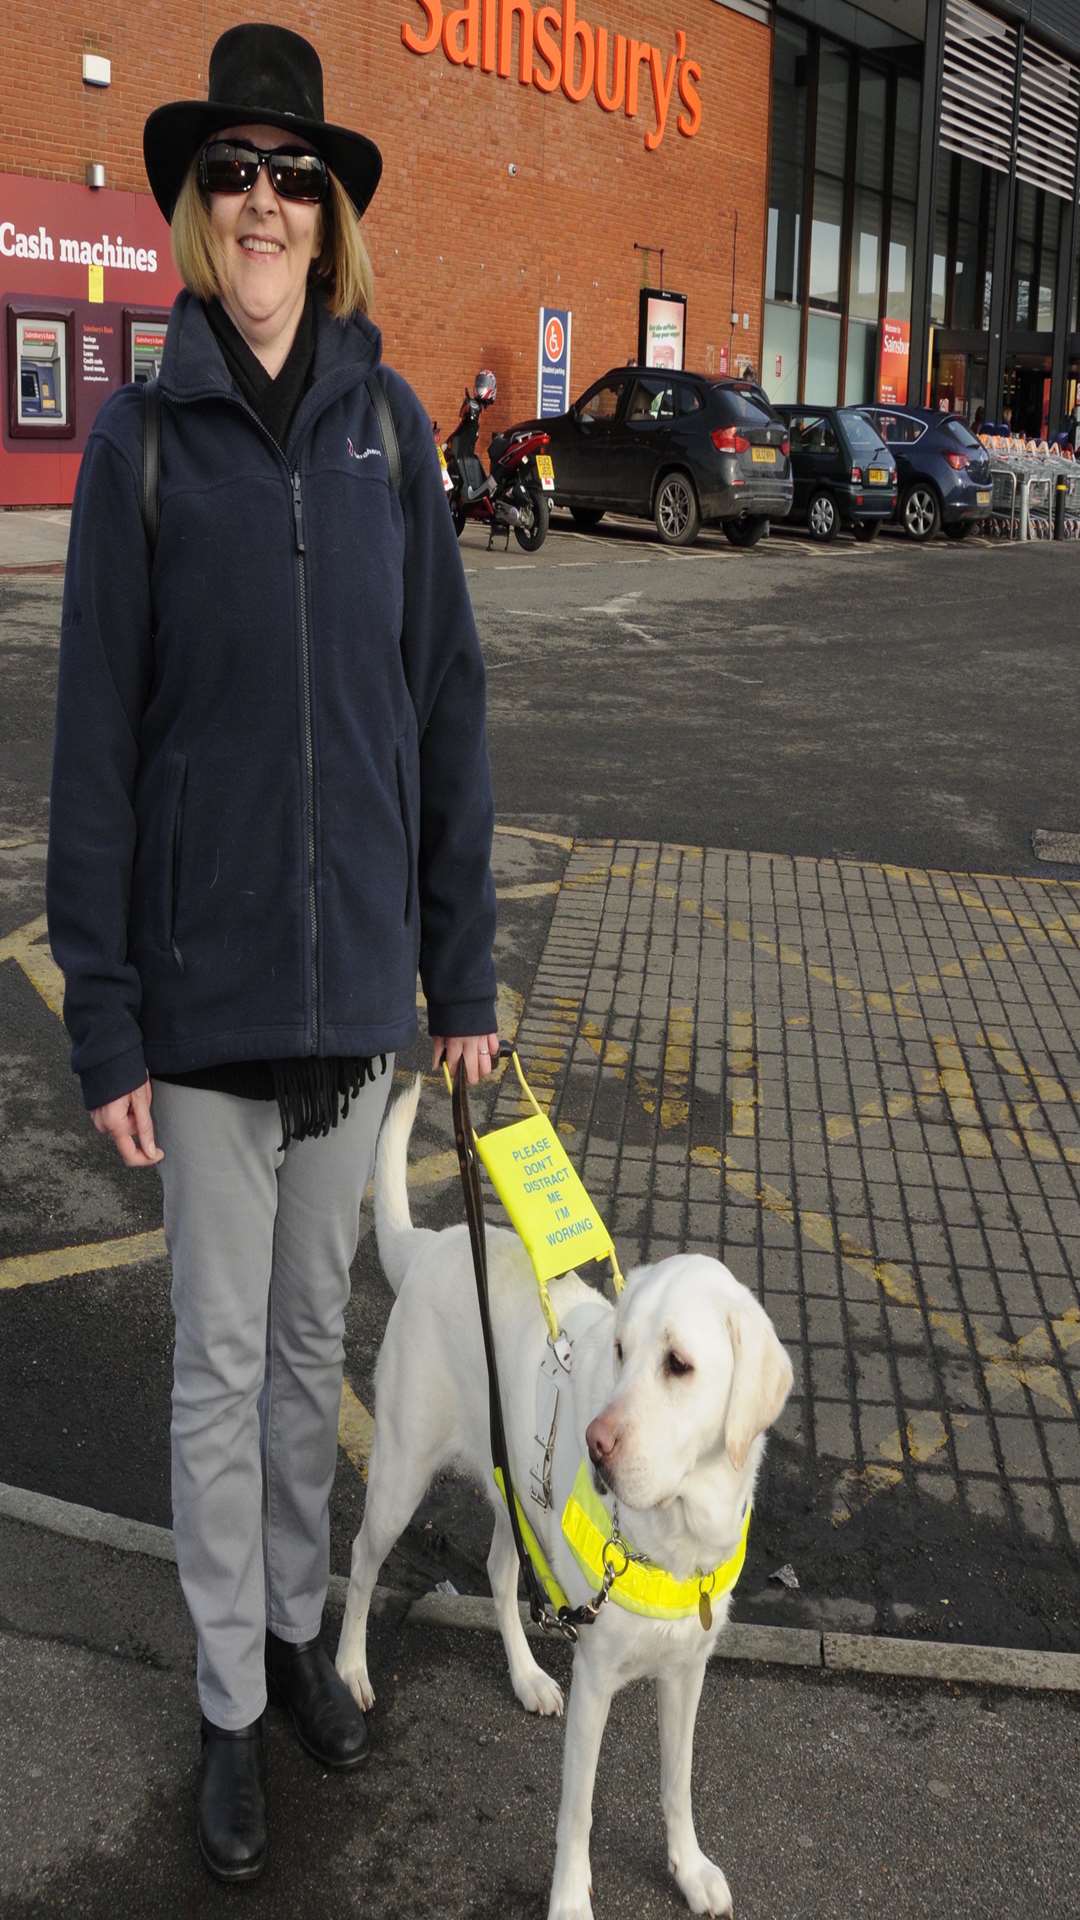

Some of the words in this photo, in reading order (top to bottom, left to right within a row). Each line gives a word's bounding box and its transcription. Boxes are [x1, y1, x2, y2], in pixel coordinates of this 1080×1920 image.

[0, 222, 54, 260] Cash
[59, 235, 157, 272] machines
[512, 1137, 551, 1161] PLEASE
[524, 1155, 553, 1176] DON'T
[523, 1167, 570, 1194] DISTRACT
[547, 1191, 563, 1204] ME
[555, 1205, 570, 1222] I'M
[546, 1218, 593, 1246] WORKING
